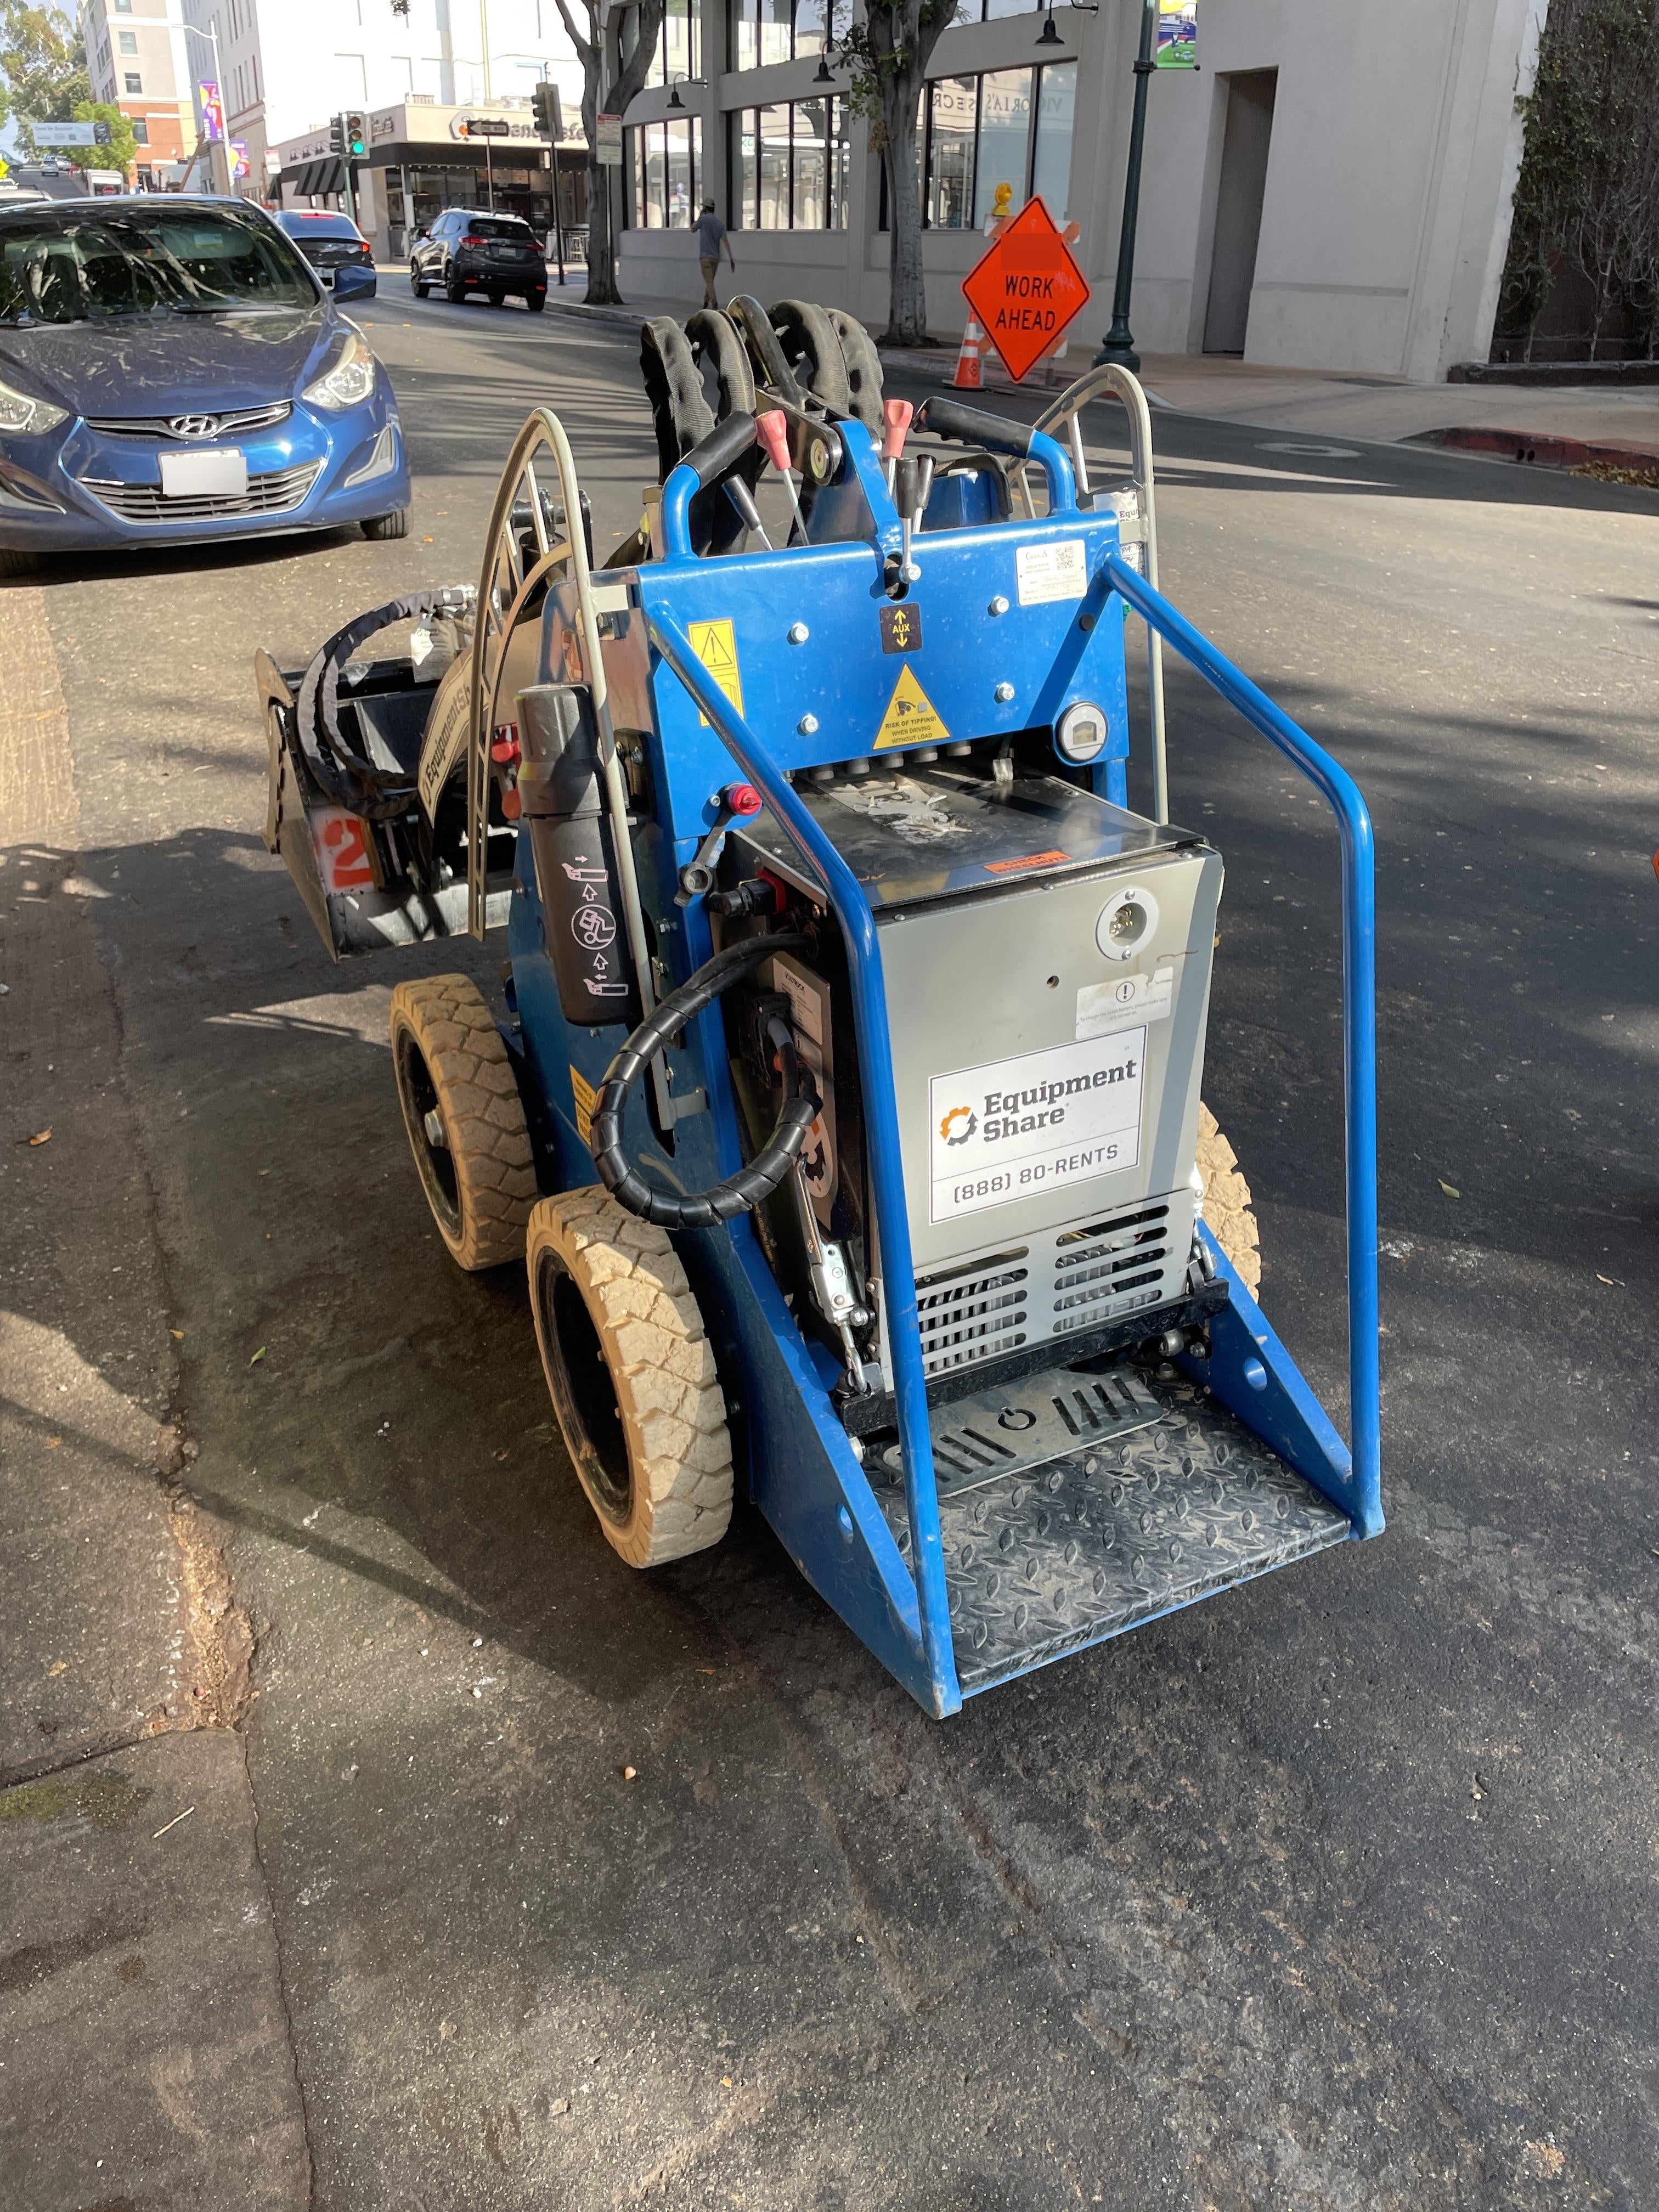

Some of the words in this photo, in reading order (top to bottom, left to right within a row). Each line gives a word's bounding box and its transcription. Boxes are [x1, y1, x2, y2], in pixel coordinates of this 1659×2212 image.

[1005, 275, 1054, 299] WORK
[995, 308, 1056, 331] AHEAD
[893, 623, 911, 634] AUX
[909, 725, 932, 733] DRIVING
[911, 716, 936, 725] TIPPING!
[426, 684, 471, 787] EquipmentSh
[324, 819, 373, 888] 2
[1004, 855, 1045, 866] CHECK
[984, 1059, 1137, 1116] Equipment
[983, 1107, 1065, 1143] Share
[954, 1173, 1011, 1204] (888)
[1019, 1144, 1119, 1184] 80-RENTS
